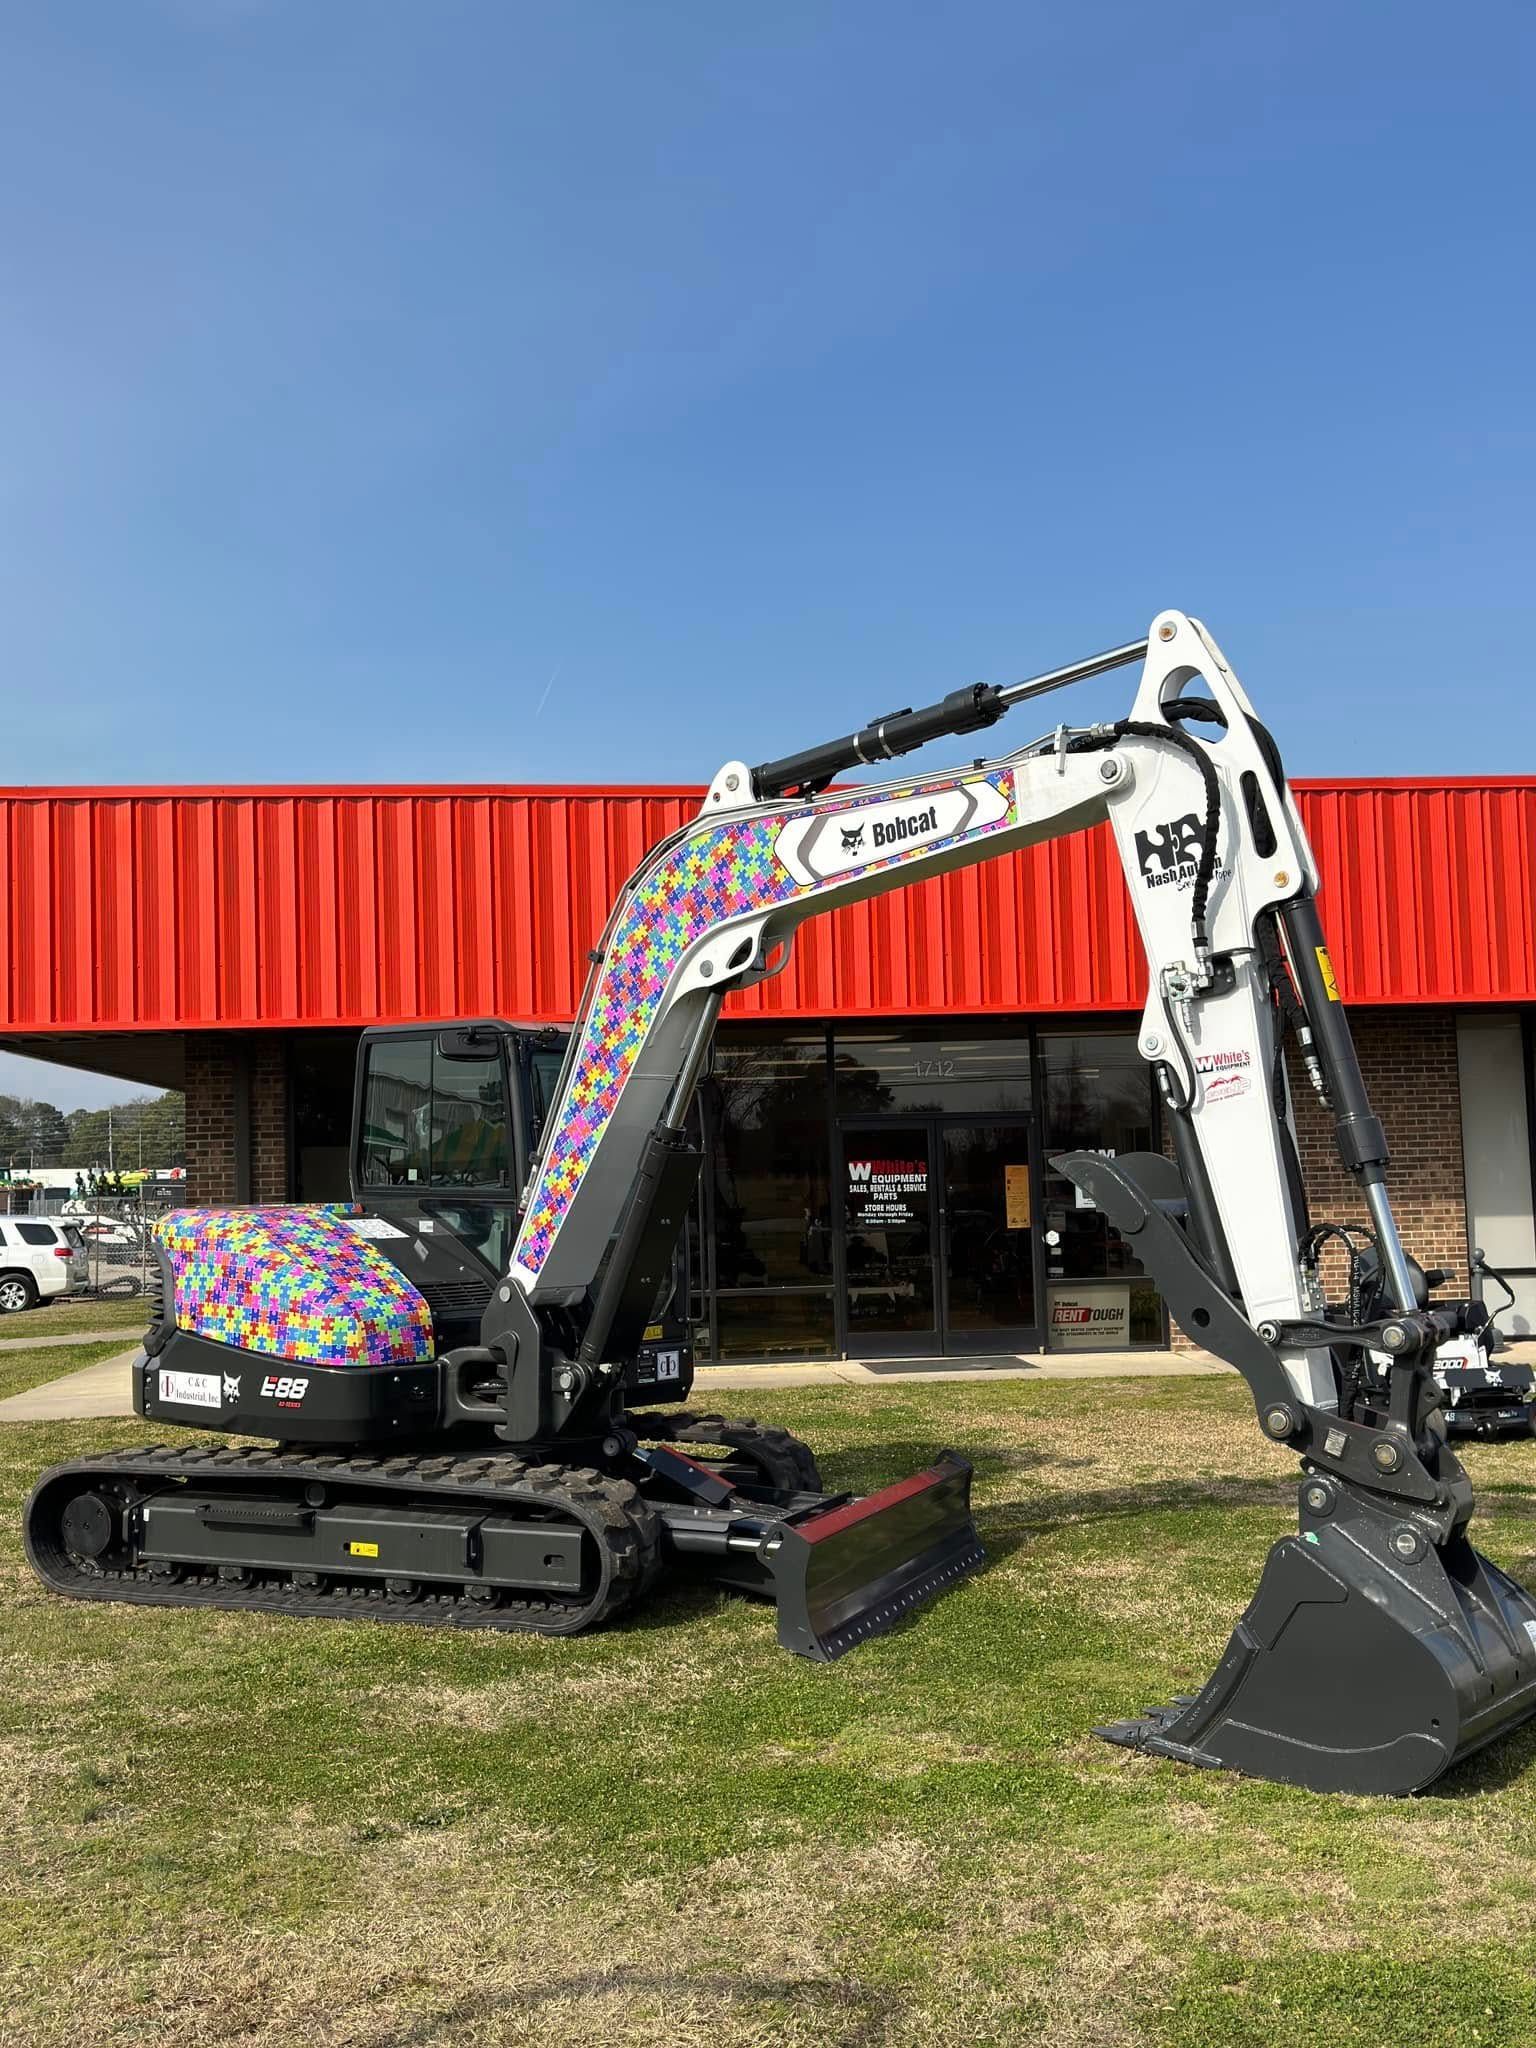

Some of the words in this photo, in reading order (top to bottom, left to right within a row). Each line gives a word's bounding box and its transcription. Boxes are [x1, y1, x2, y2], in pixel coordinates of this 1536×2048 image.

[872, 806, 938, 847] Bobcat
[1146, 868, 1177, 889] Nash
[1213, 1050, 1250, 1066] White's
[914, 1060, 954, 1077] 1712
[1216, 1061, 1251, 1071] EQUIPMENT
[872, 1160, 927, 1174] White's
[872, 1174, 927, 1184] EQUIPMENT
[849, 1184, 869, 1194] SALES,
[870, 1184, 896, 1192] RENTALS
[897, 1184, 902, 1192] &
[903, 1184, 927, 1192] SERVICE
[873, 1192, 898, 1201] PARTS
[1054, 1309, 1086, 1322] RENT
[1090, 1308, 1124, 1321] TOUGH
[188, 1376, 194, 1387] C
[194, 1377, 200, 1388] &
[201, 1378, 207, 1388] C
[260, 1376, 309, 1399] E88
[176, 1388, 207, 1402] Industrial,
